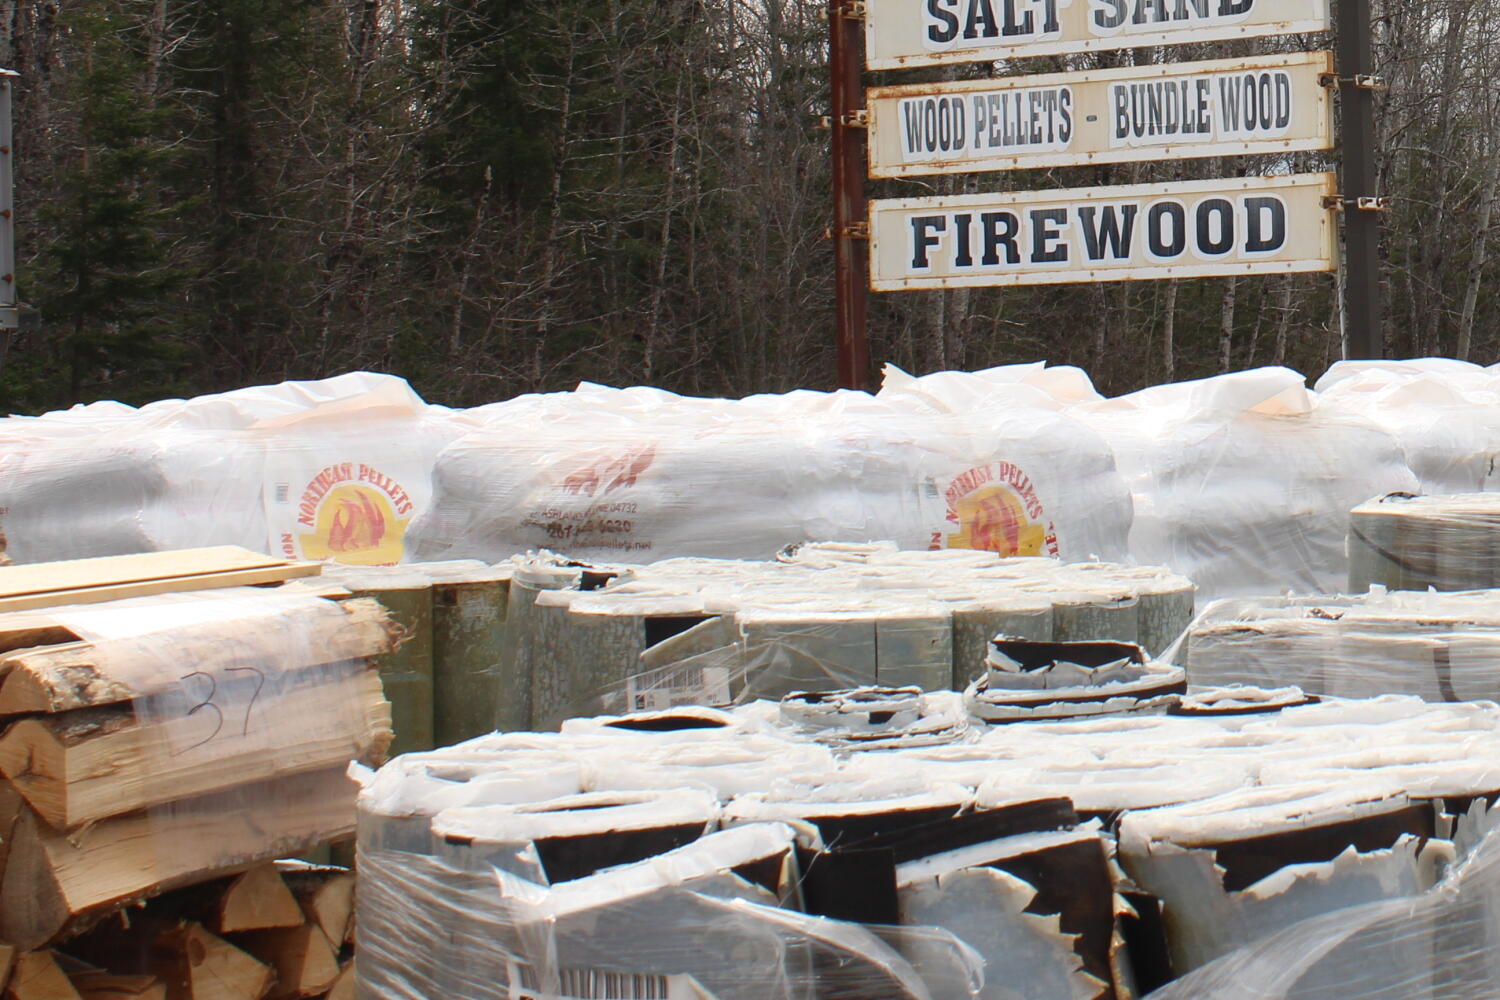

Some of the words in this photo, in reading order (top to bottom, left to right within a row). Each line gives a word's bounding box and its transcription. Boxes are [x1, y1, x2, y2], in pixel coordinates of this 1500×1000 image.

[904, 97, 966, 153] WOOD
[973, 88, 1072, 149] PELLETS
[1114, 79, 1211, 139] BUNDLE
[1219, 73, 1290, 132] WOOD
[911, 196, 1286, 268] FIREWOOD
[298, 462, 352, 527] NORTHEAST
[358, 463, 413, 515] PELLETS
[171, 666, 265, 757] 37
